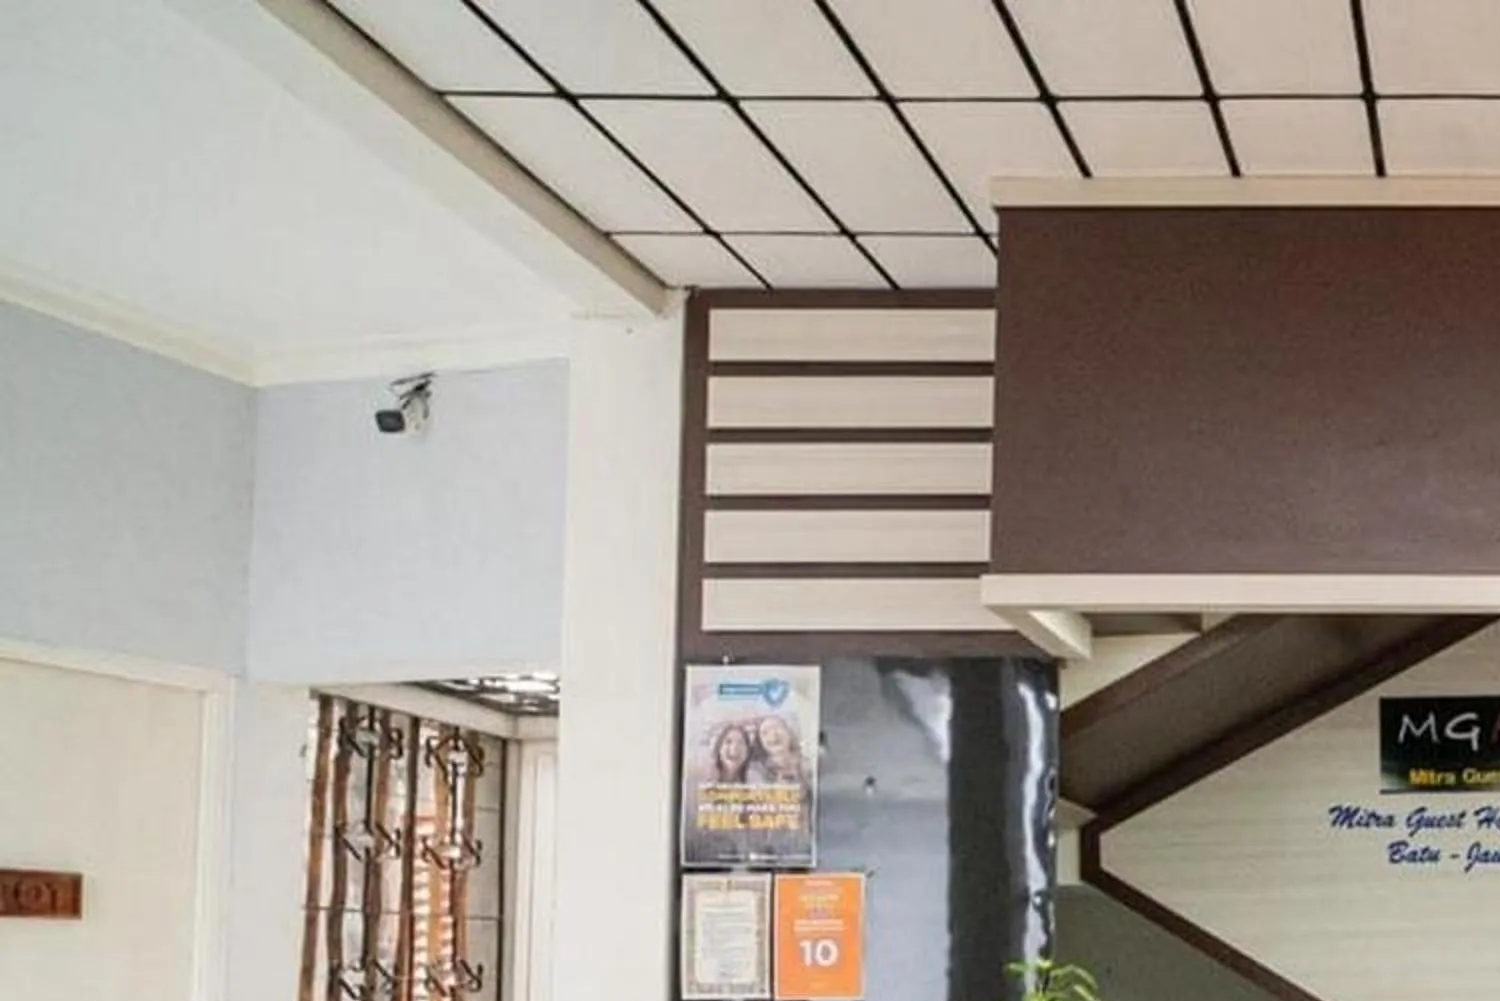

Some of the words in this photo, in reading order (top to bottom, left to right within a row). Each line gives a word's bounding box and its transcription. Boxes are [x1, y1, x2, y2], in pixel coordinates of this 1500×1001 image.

[1409, 768, 1457, 785] Mitra
[1328, 805, 1395, 829] Mitra
[1406, 806, 1467, 837] Guest
[1388, 840, 1441, 864] Batu
[800, 939, 839, 967] 10
